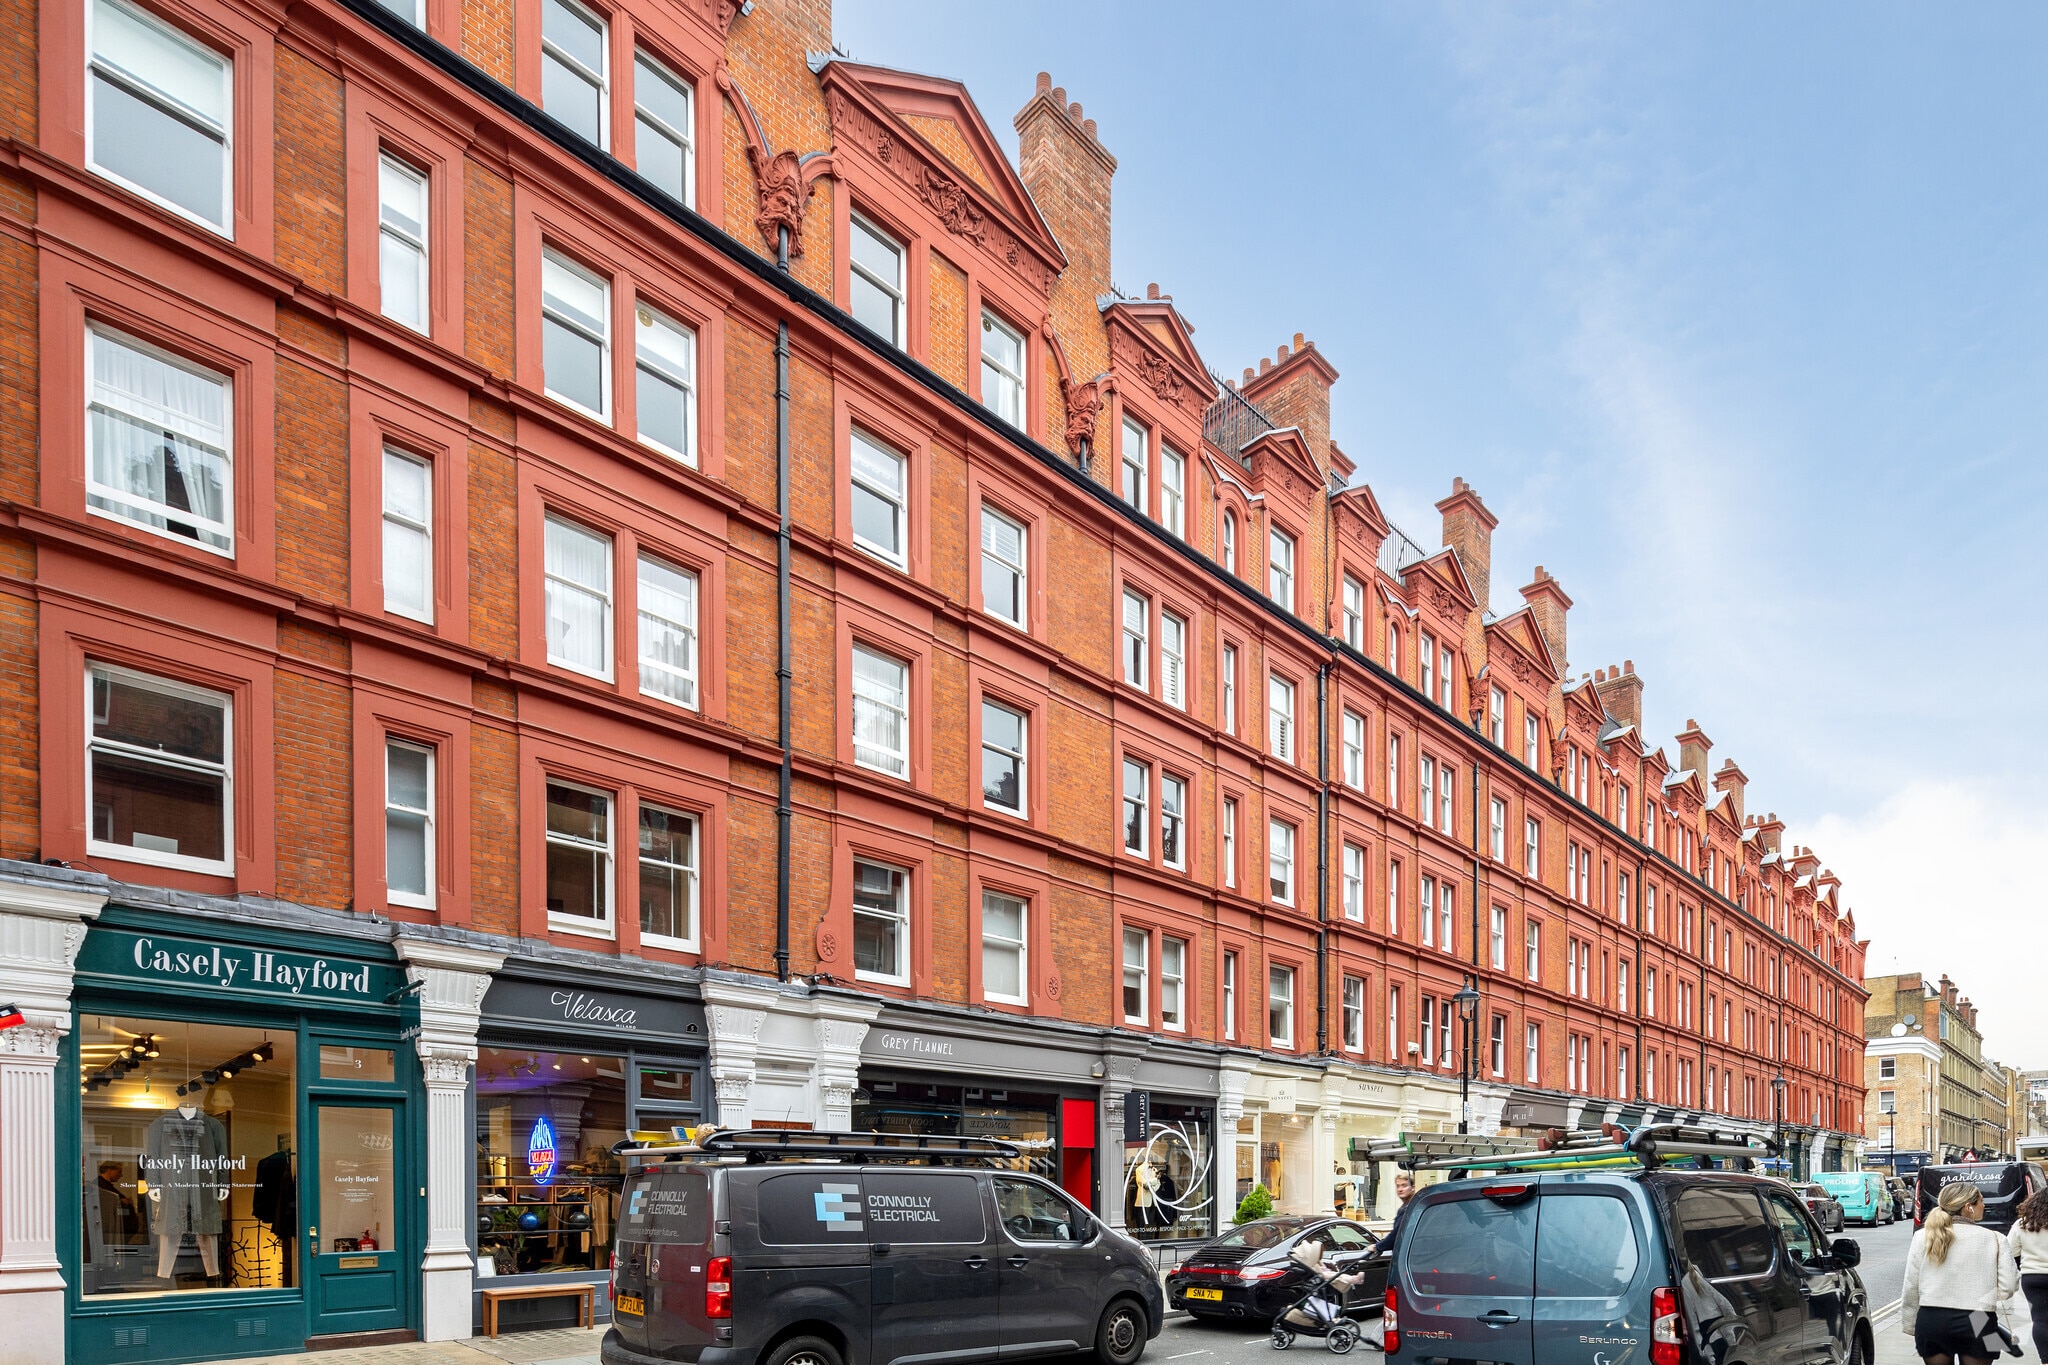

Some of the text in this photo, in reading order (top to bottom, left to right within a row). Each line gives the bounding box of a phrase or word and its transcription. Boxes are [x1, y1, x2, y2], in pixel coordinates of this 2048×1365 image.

[134, 938, 370, 994] Casely-Hayford
[550, 991, 637, 1025] Velasca
[881, 1034, 954, 1055] GREY FLANNEL
[354, 1059, 362, 1069] 3
[1208, 1074, 1214, 1083] 7
[1358, 1083, 1385, 1093] SUNSPEL
[1939, 1170, 2005, 1187] grandirosa
[651, 1190, 688, 1202] CONNOLLY
[868, 1195, 932, 1208] CONNOLLY
[869, 1209, 940, 1222] ELECTRICAL
